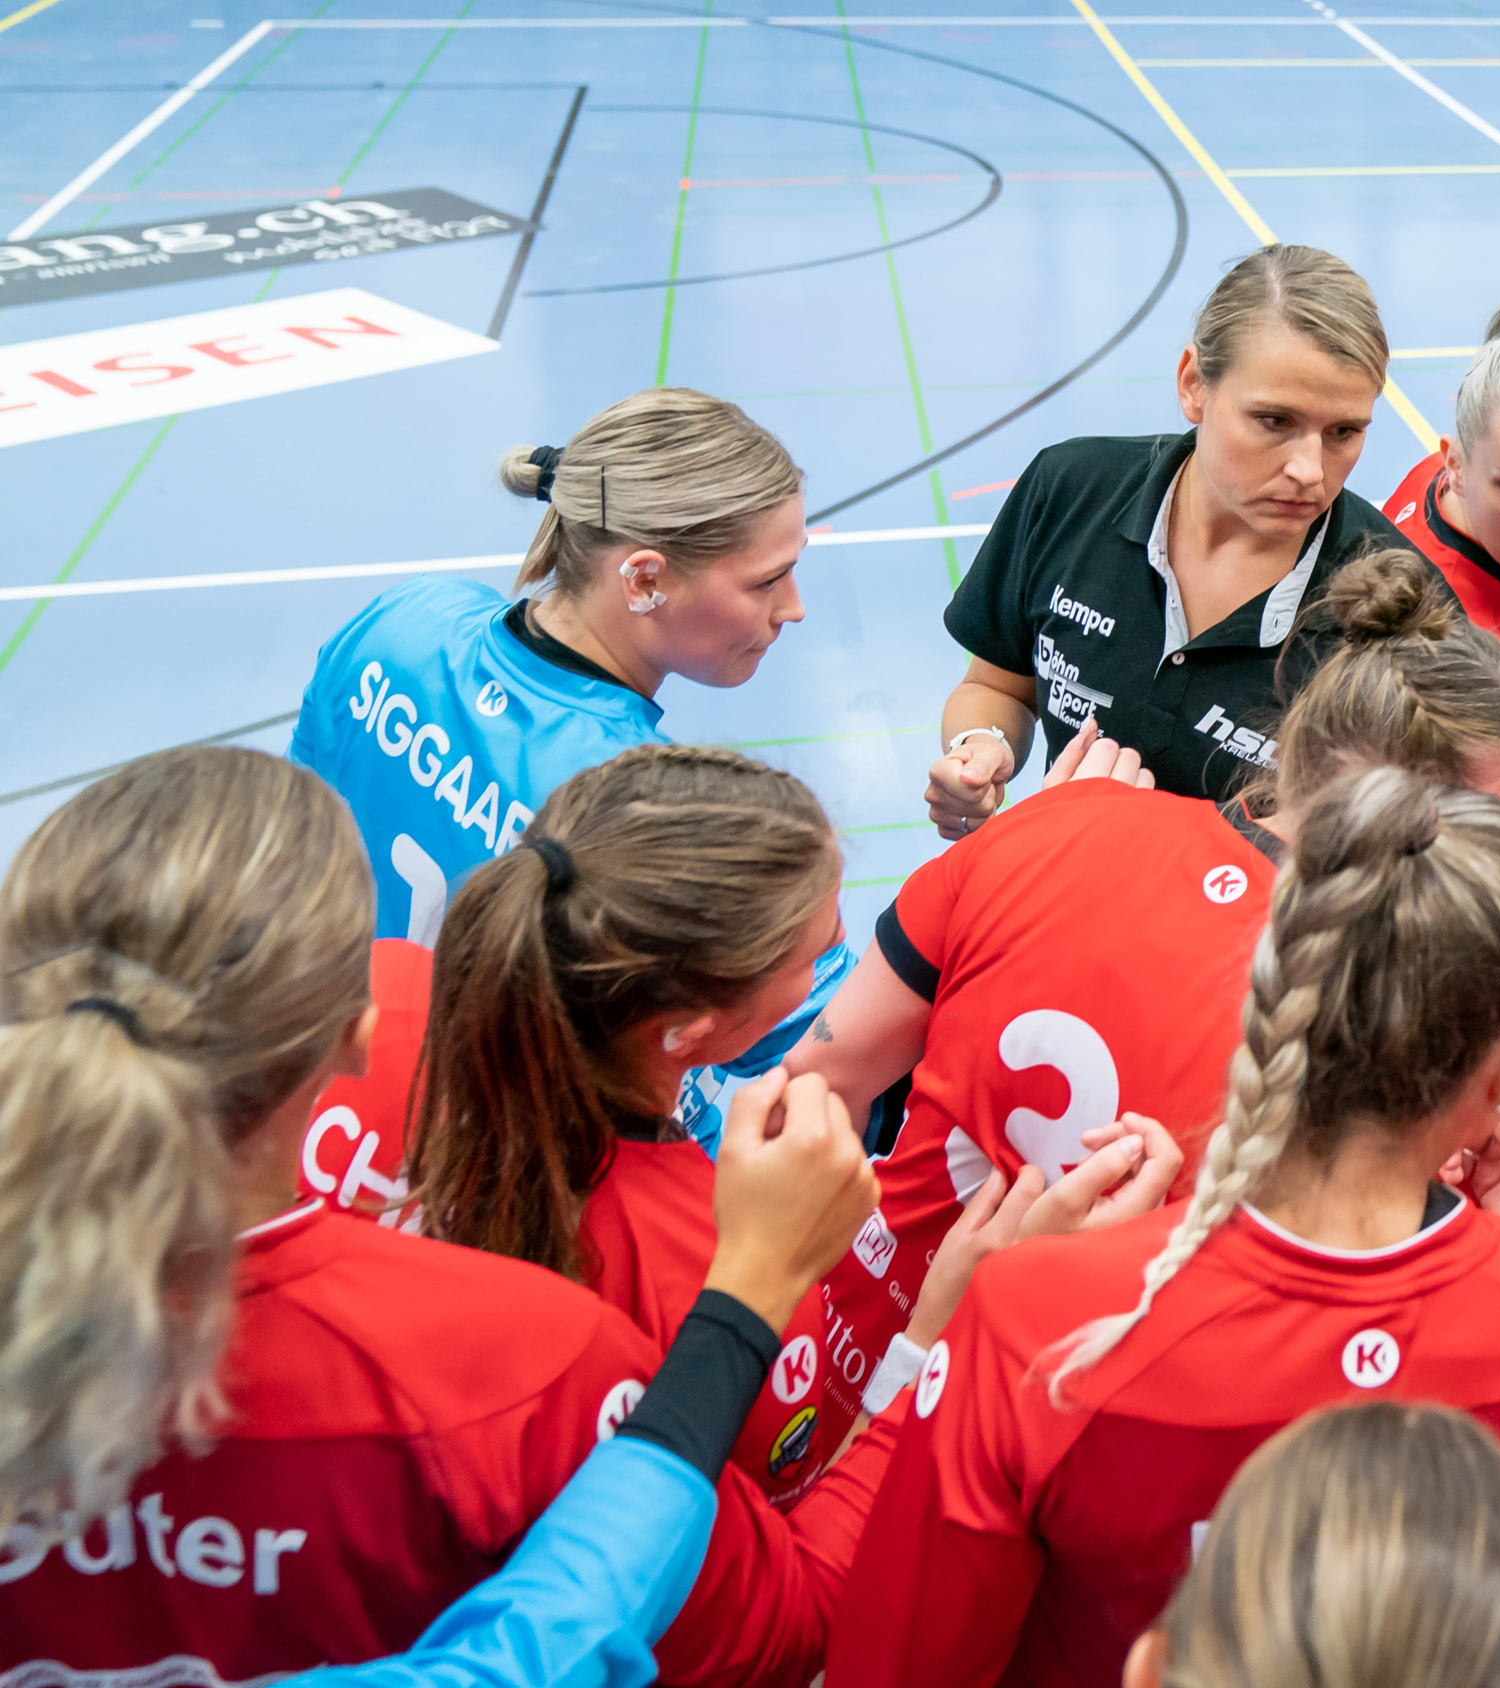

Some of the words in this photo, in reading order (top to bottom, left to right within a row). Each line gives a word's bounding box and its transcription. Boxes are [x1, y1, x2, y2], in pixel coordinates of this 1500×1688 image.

[0, 316, 403, 412] ISEN
[1048, 584, 1116, 637] Kempa
[1049, 675, 1098, 719] Sport
